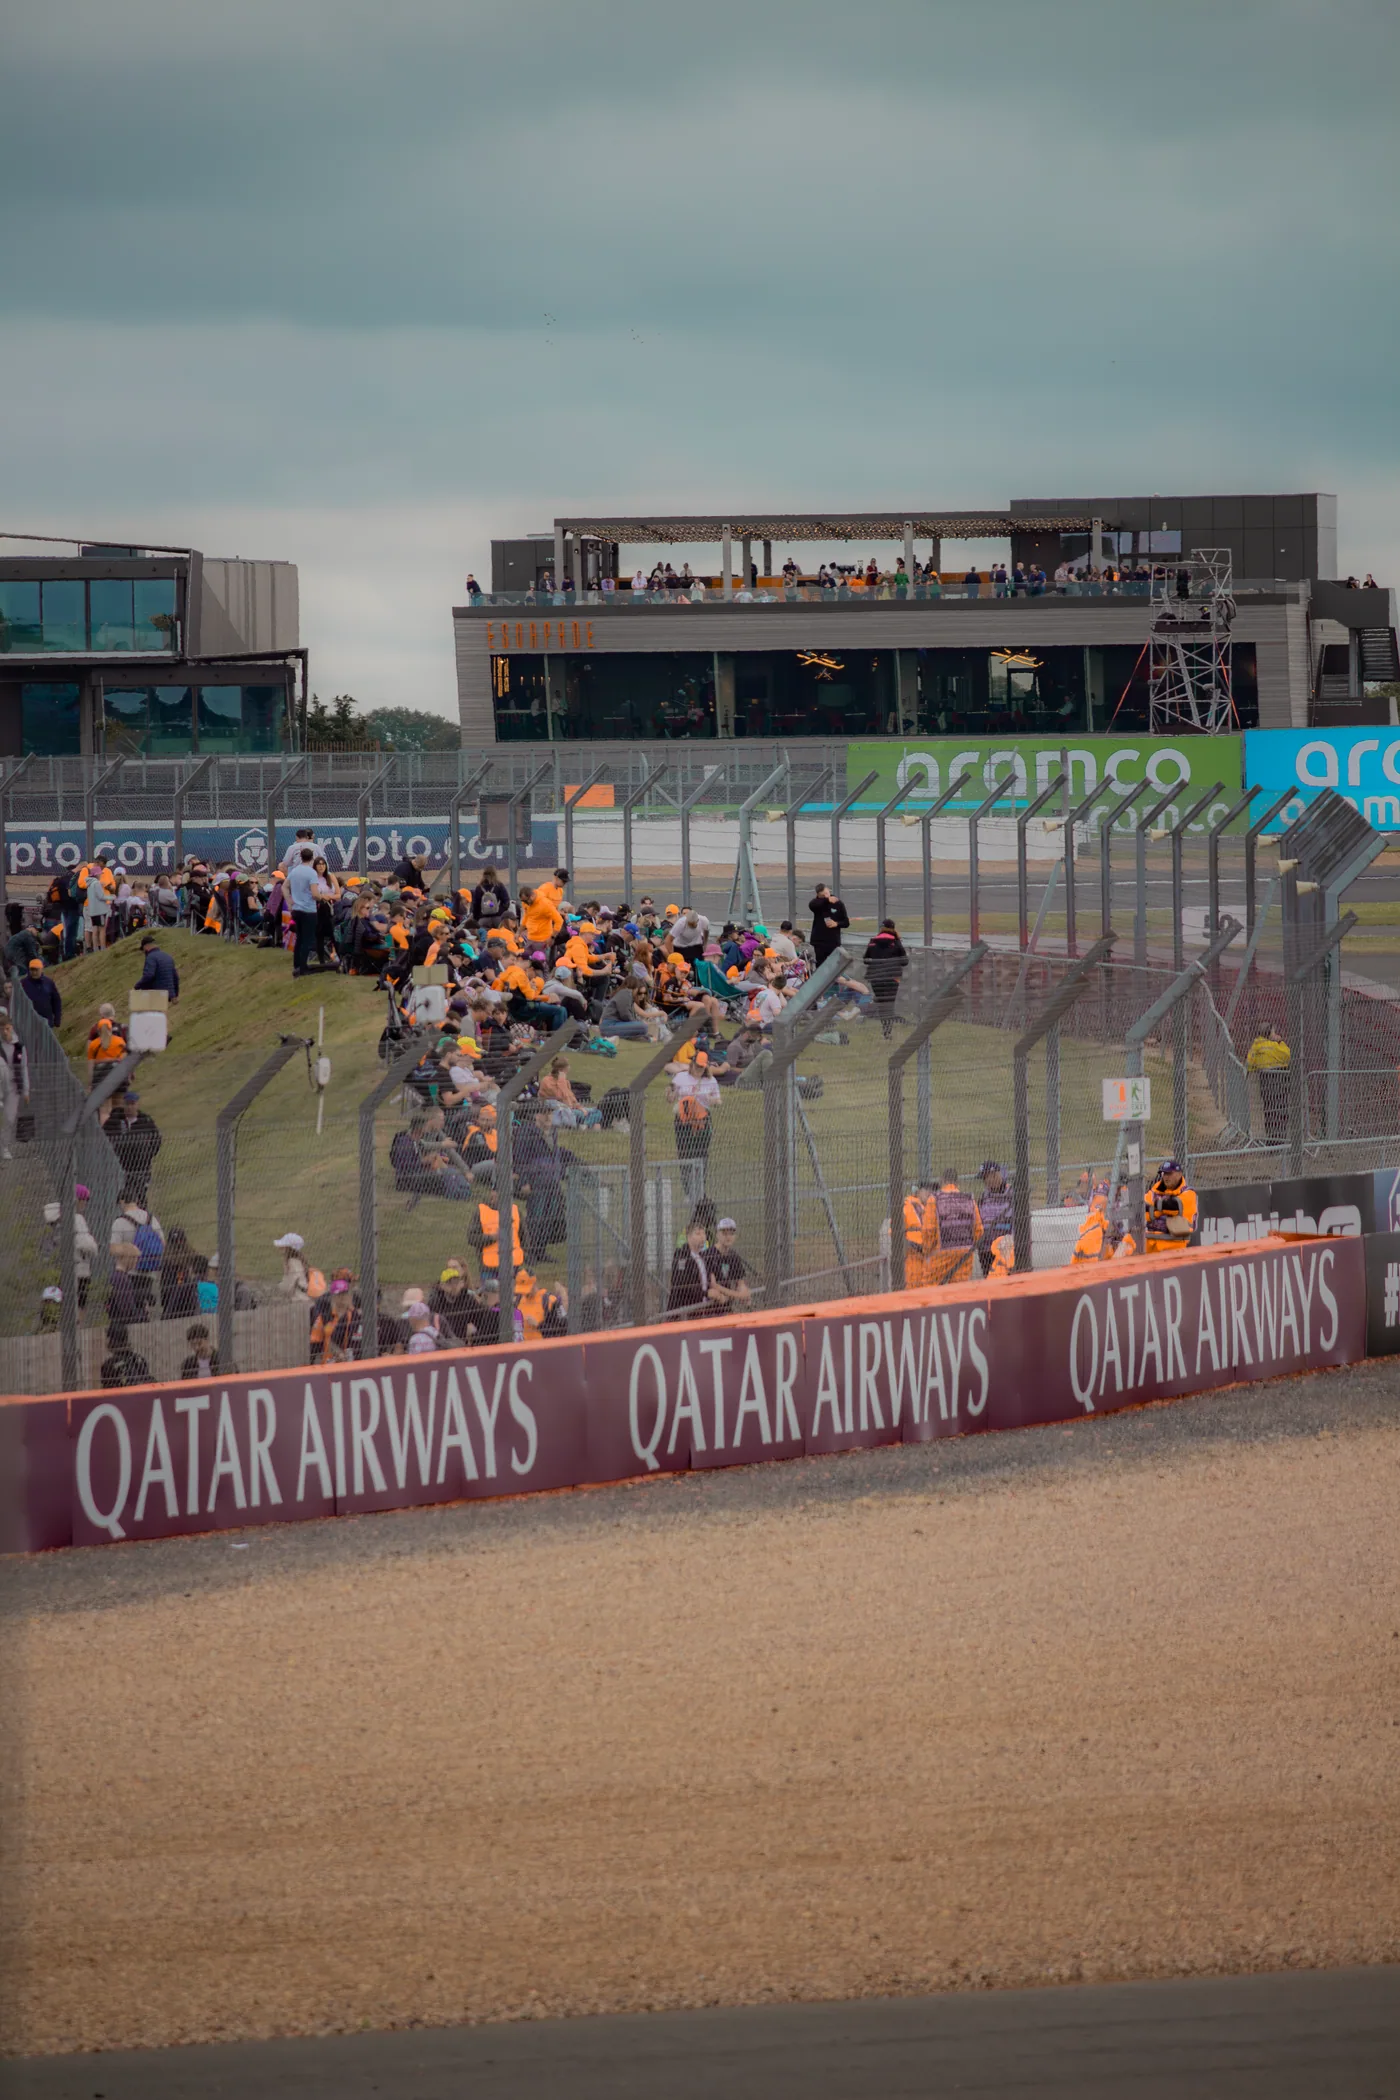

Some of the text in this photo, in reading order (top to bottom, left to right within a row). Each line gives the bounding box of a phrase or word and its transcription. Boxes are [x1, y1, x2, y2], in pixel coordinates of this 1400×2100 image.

[486, 621, 595, 649] ESCAPADE
[896, 748, 1192, 799] aramco
[628, 1307, 990, 1470] QATAR AIRWAYS
[1069, 1248, 1339, 1413] QATAR AIRWAYS
[75, 1358, 539, 1539] QATAR AIRWAYS
